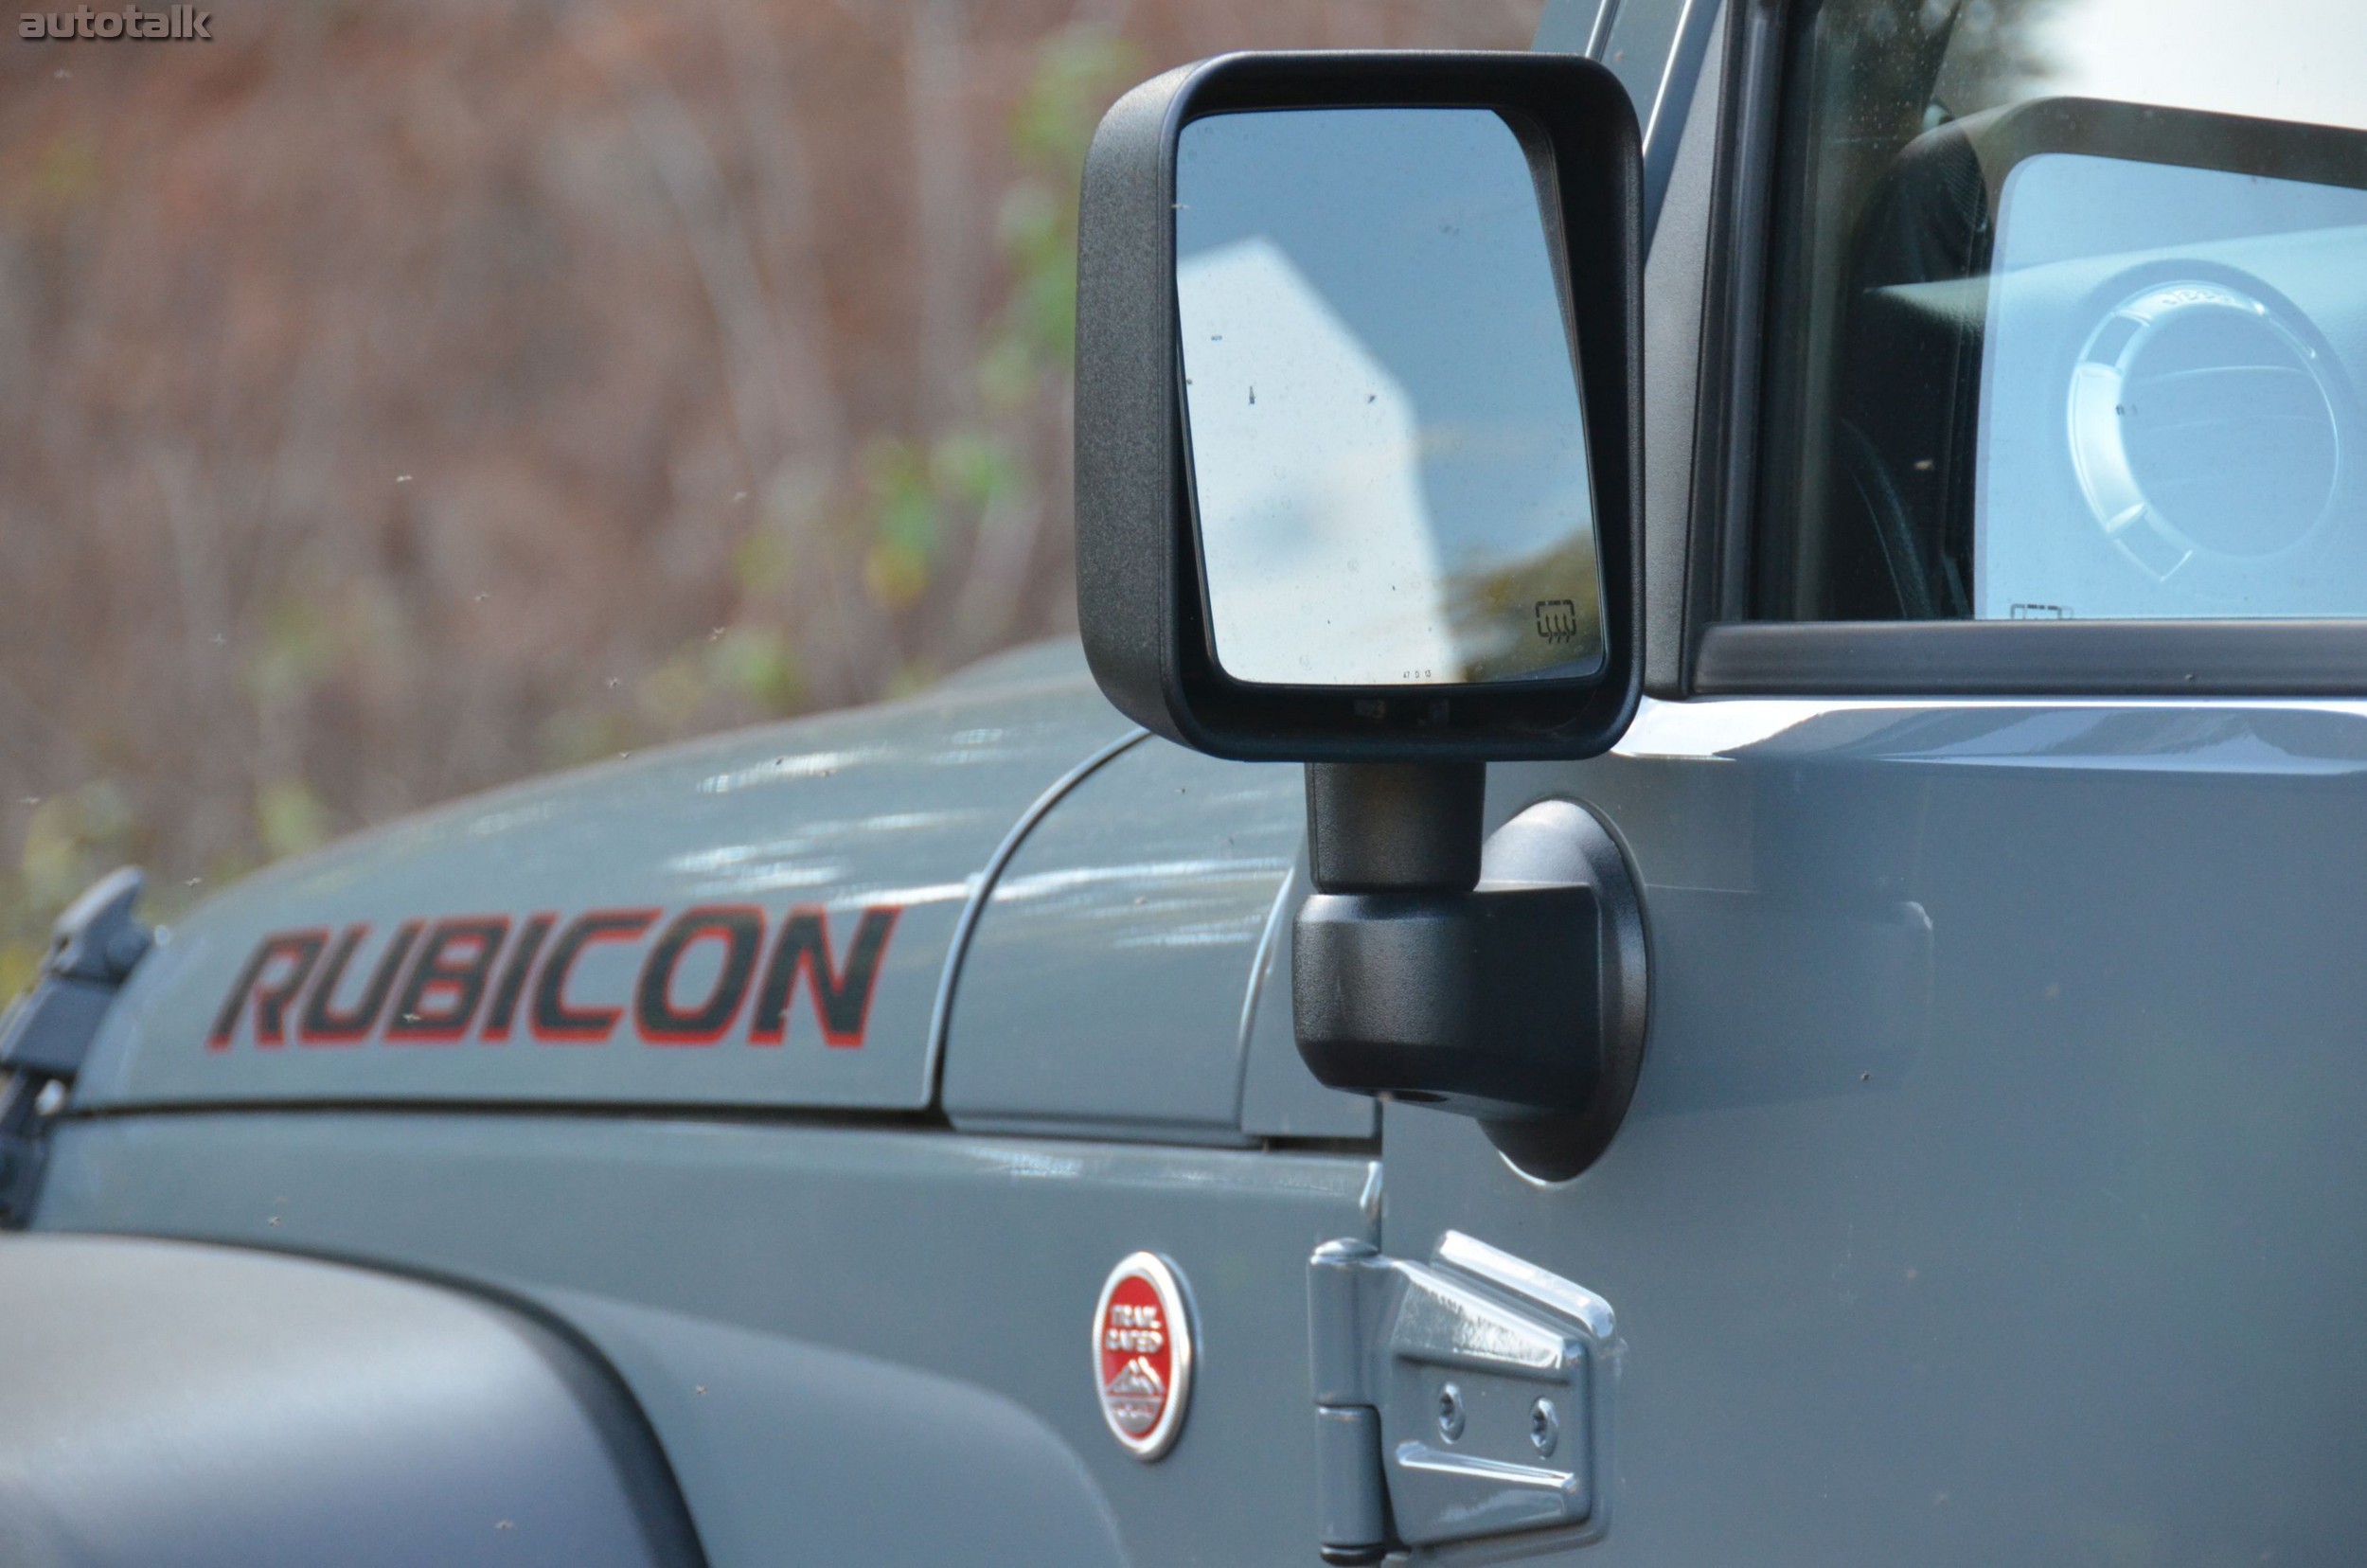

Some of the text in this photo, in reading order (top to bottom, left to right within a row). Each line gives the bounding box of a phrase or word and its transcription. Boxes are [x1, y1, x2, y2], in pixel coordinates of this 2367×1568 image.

[205, 904, 903, 1052] RUBICON
[1111, 1304, 1162, 1329] TRAIL
[1106, 1327, 1165, 1354] RATED
